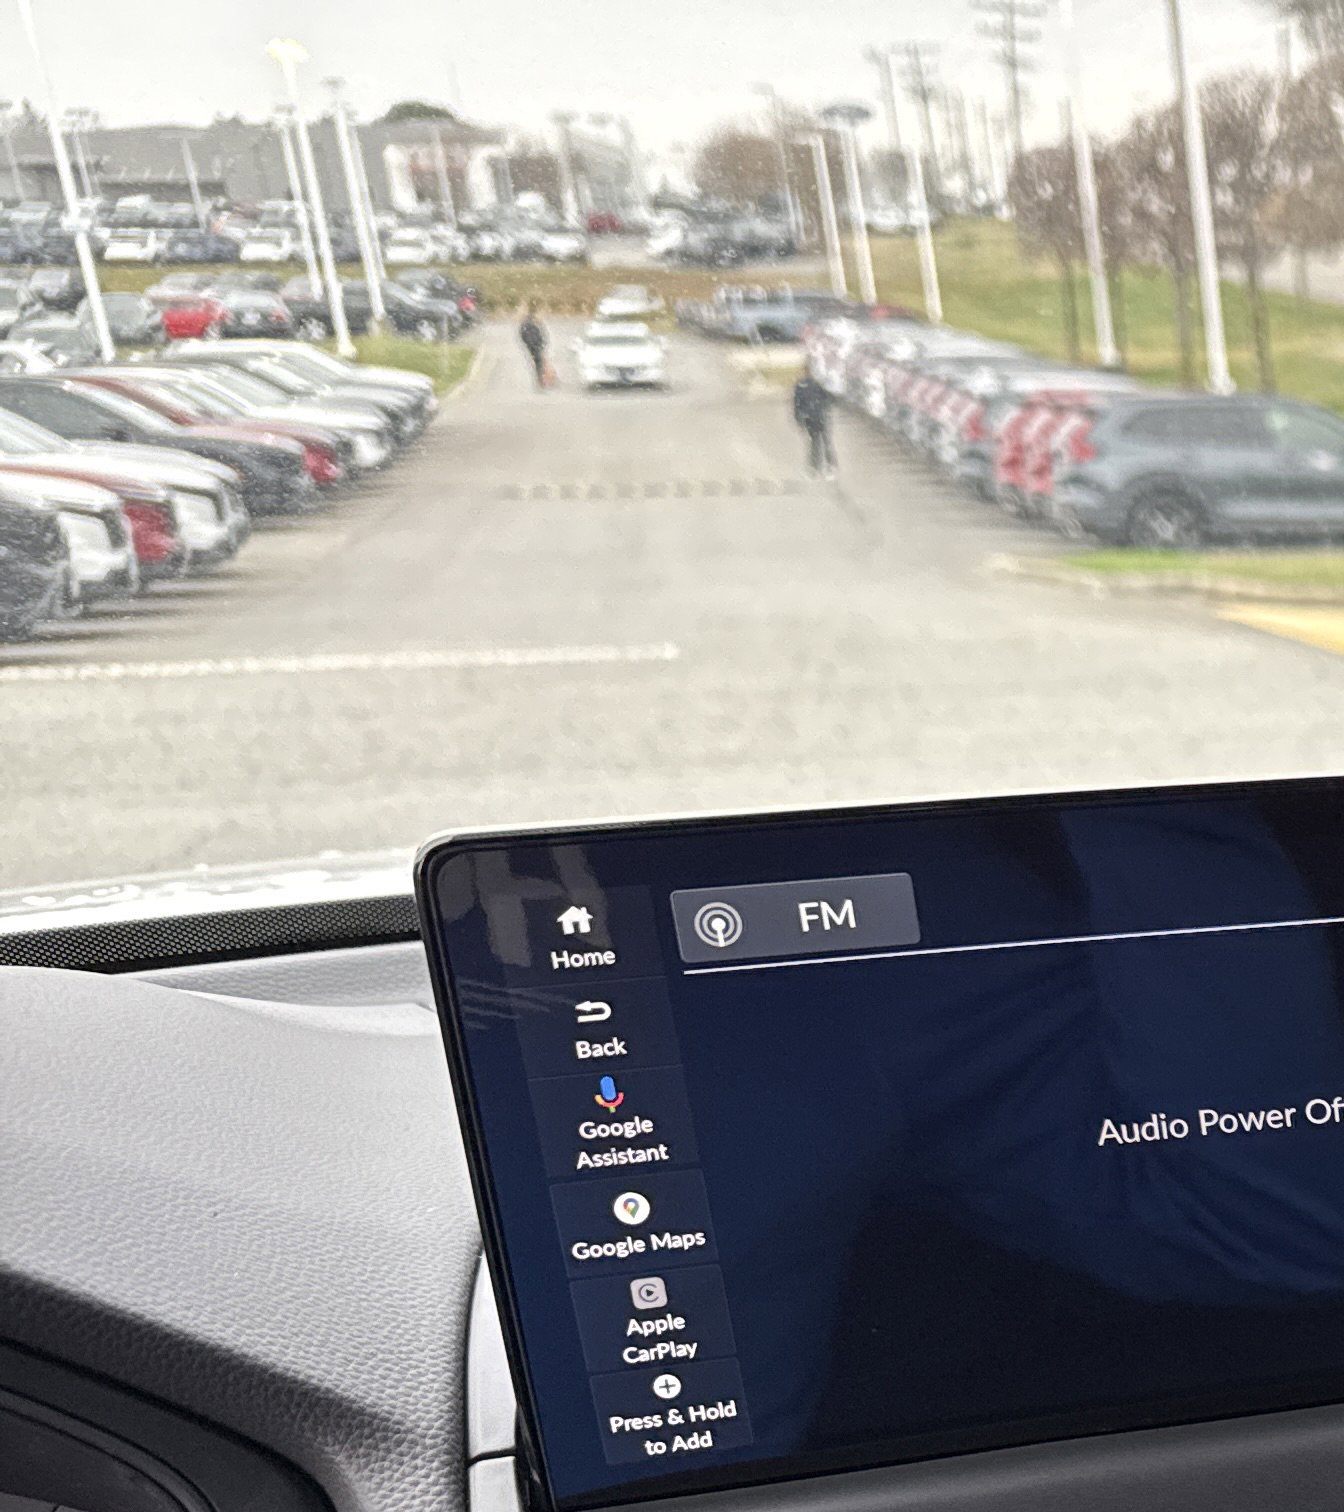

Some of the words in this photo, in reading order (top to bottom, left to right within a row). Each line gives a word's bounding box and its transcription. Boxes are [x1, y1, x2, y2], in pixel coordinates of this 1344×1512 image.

[797, 899, 857, 933] FM
[550, 949, 616, 970] Home
[575, 1036, 628, 1060] Back
[578, 1115, 654, 1140] Google
[1097, 1112, 1189, 1147] Audio
[1198, 1107, 1297, 1136] Power
[576, 1143, 670, 1170] Assistant
[571, 1238, 646, 1260] Google
[650, 1231, 706, 1252] Maps
[626, 1313, 686, 1338] Apple
[622, 1340, 698, 1364] CarPlay
[609, 1414, 664, 1434] Press
[667, 1408, 686, 1426] &
[688, 1399, 738, 1423] Hold
[644, 1440, 667, 1456] to
[671, 1430, 713, 1453] Add
